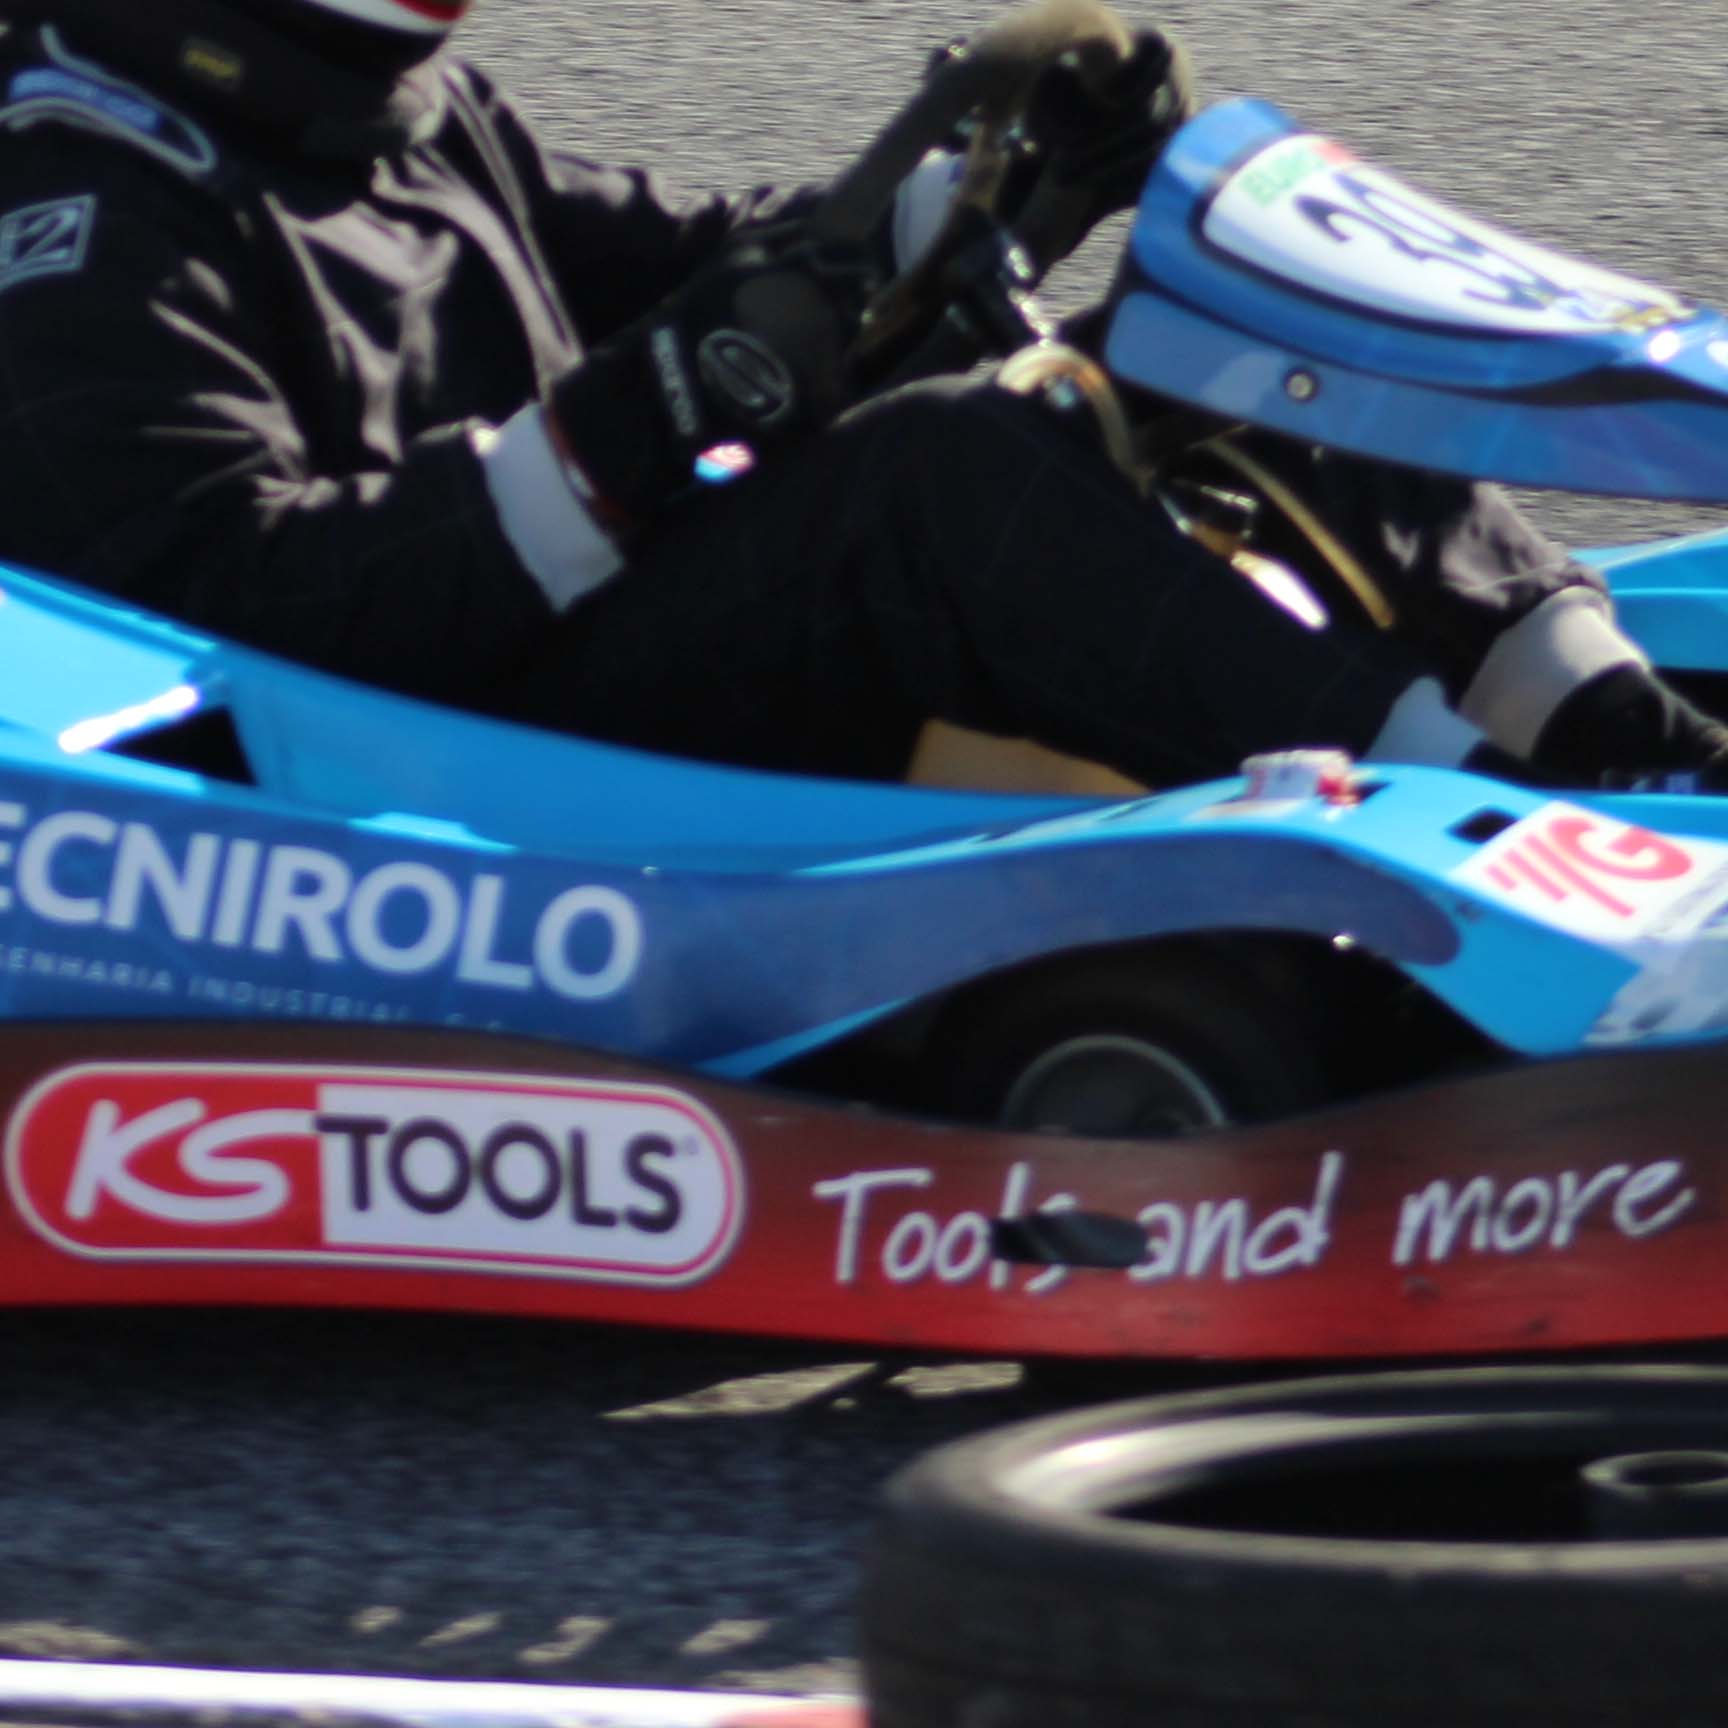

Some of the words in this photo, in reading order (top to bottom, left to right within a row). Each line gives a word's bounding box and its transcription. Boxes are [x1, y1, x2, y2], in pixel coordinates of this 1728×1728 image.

[63, 1096, 314, 1223] KS
[313, 1113, 687, 1234] TOOLS
[1128, 1151, 1342, 1282] and
[1392, 1155, 1697, 1265] more
